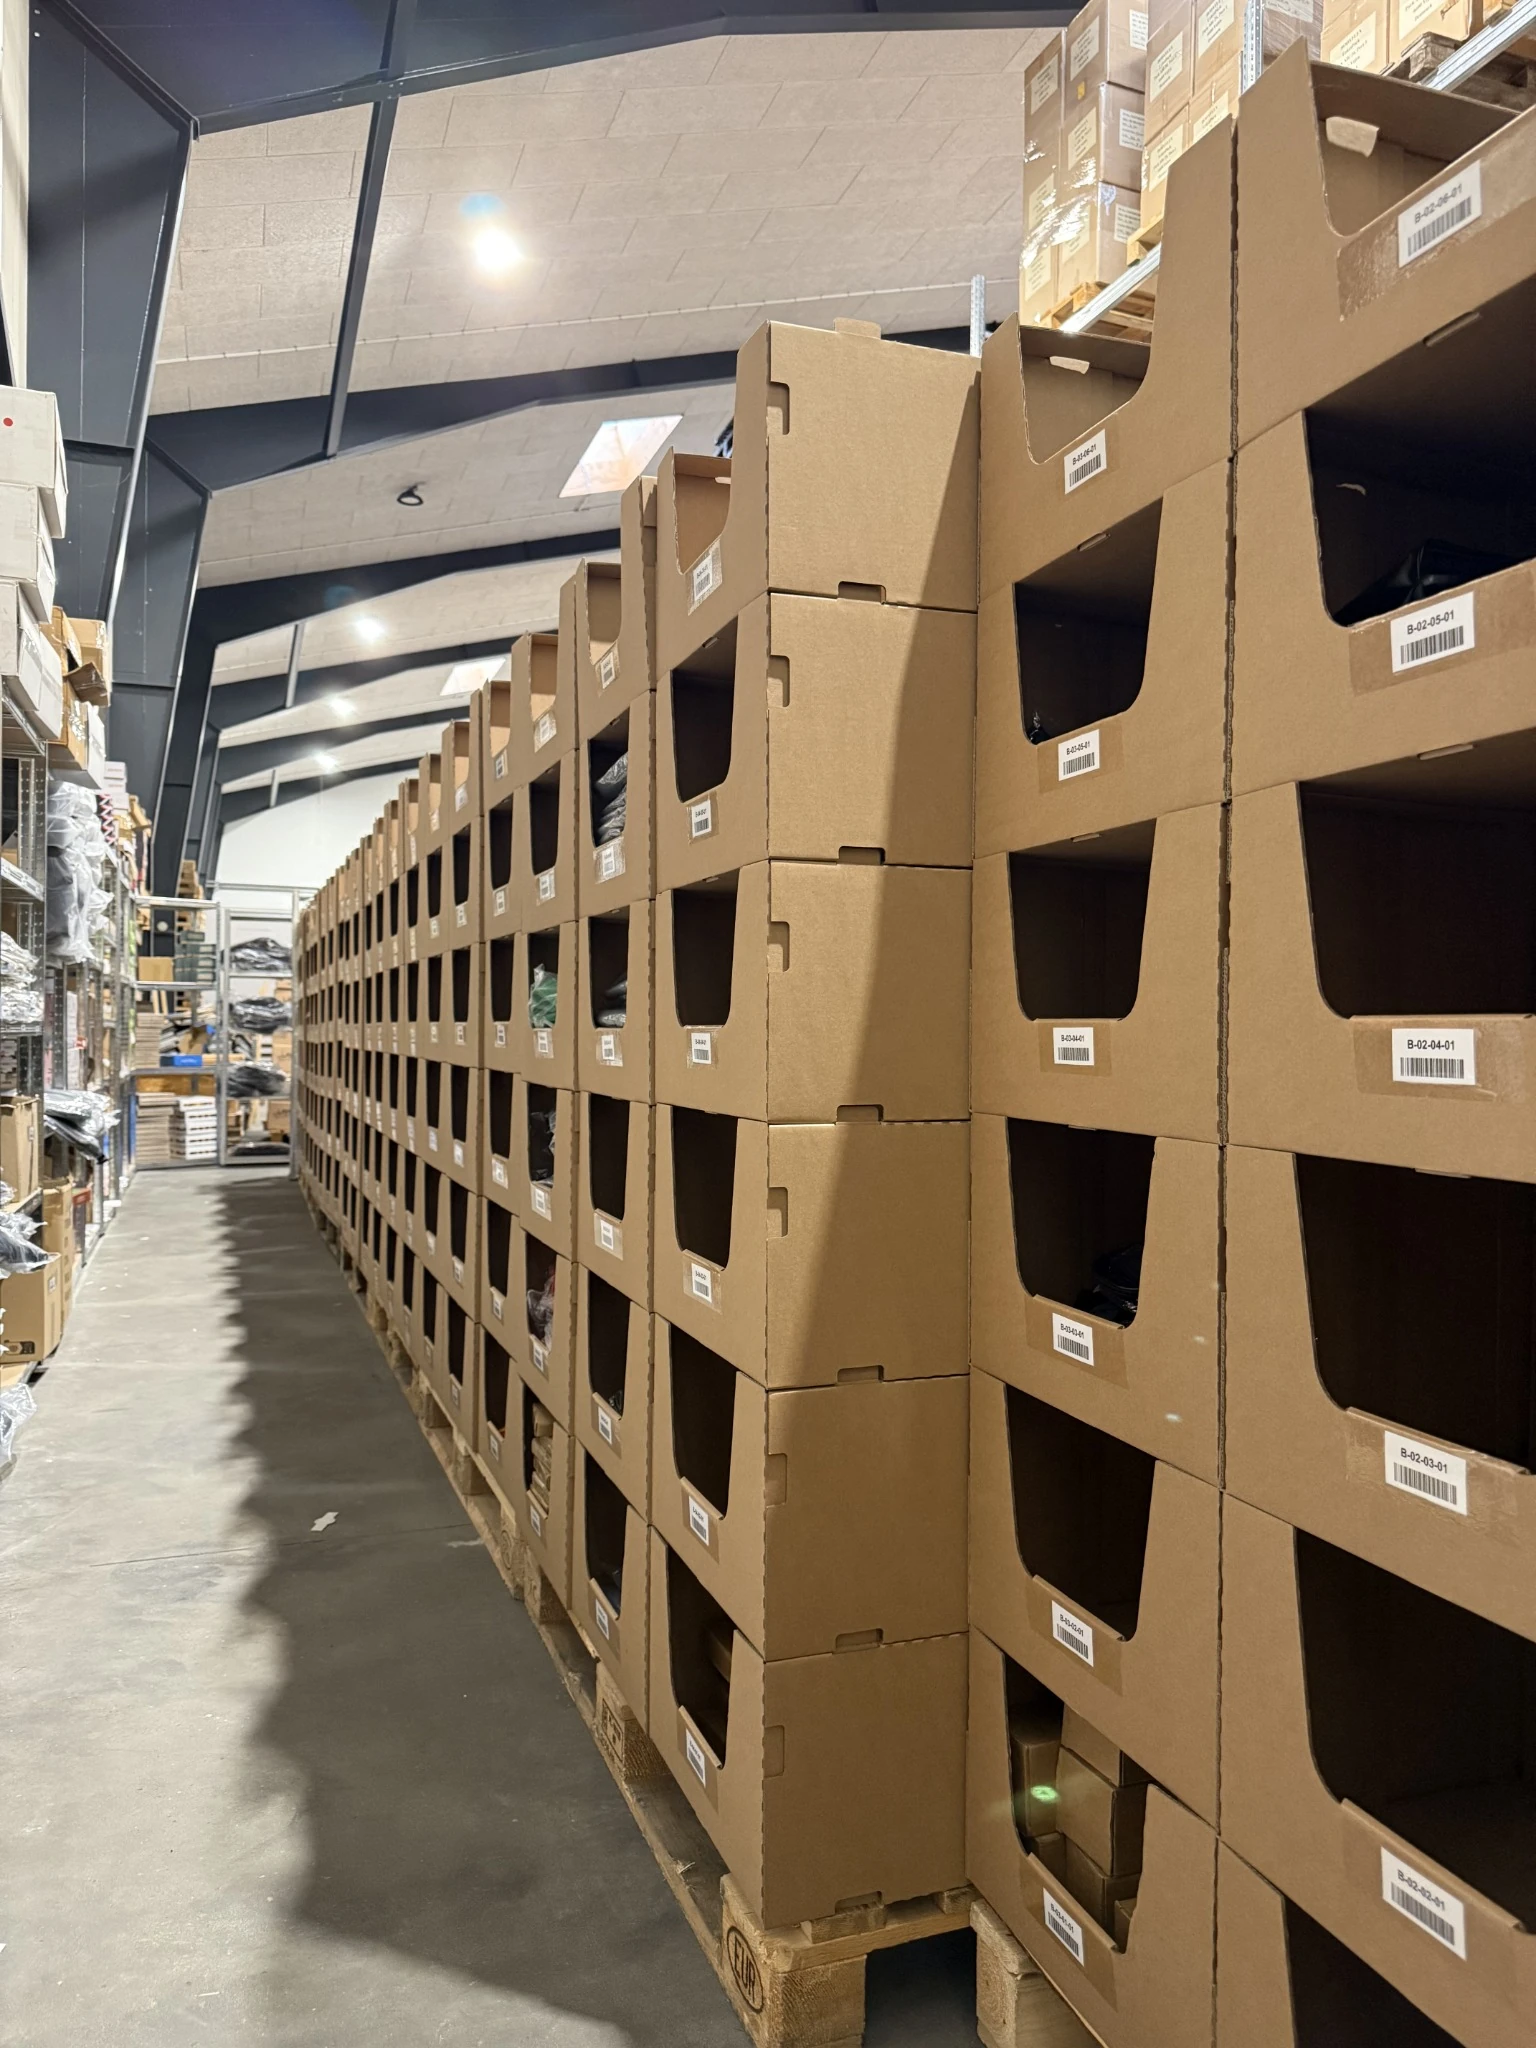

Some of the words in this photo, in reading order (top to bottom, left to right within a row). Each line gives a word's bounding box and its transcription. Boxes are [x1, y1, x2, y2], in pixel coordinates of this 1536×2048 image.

[1414, 183, 1462, 224] B-02-06-01
[1407, 609, 1454, 635] B-02-05-01
[1407, 1039, 1455, 1051] B-02-04-01
[1400, 1447, 1447, 1474] B-02-03-01
[1398, 1869, 1446, 1911] B-02-02-01
[734, 1934, 756, 2004] EUR
